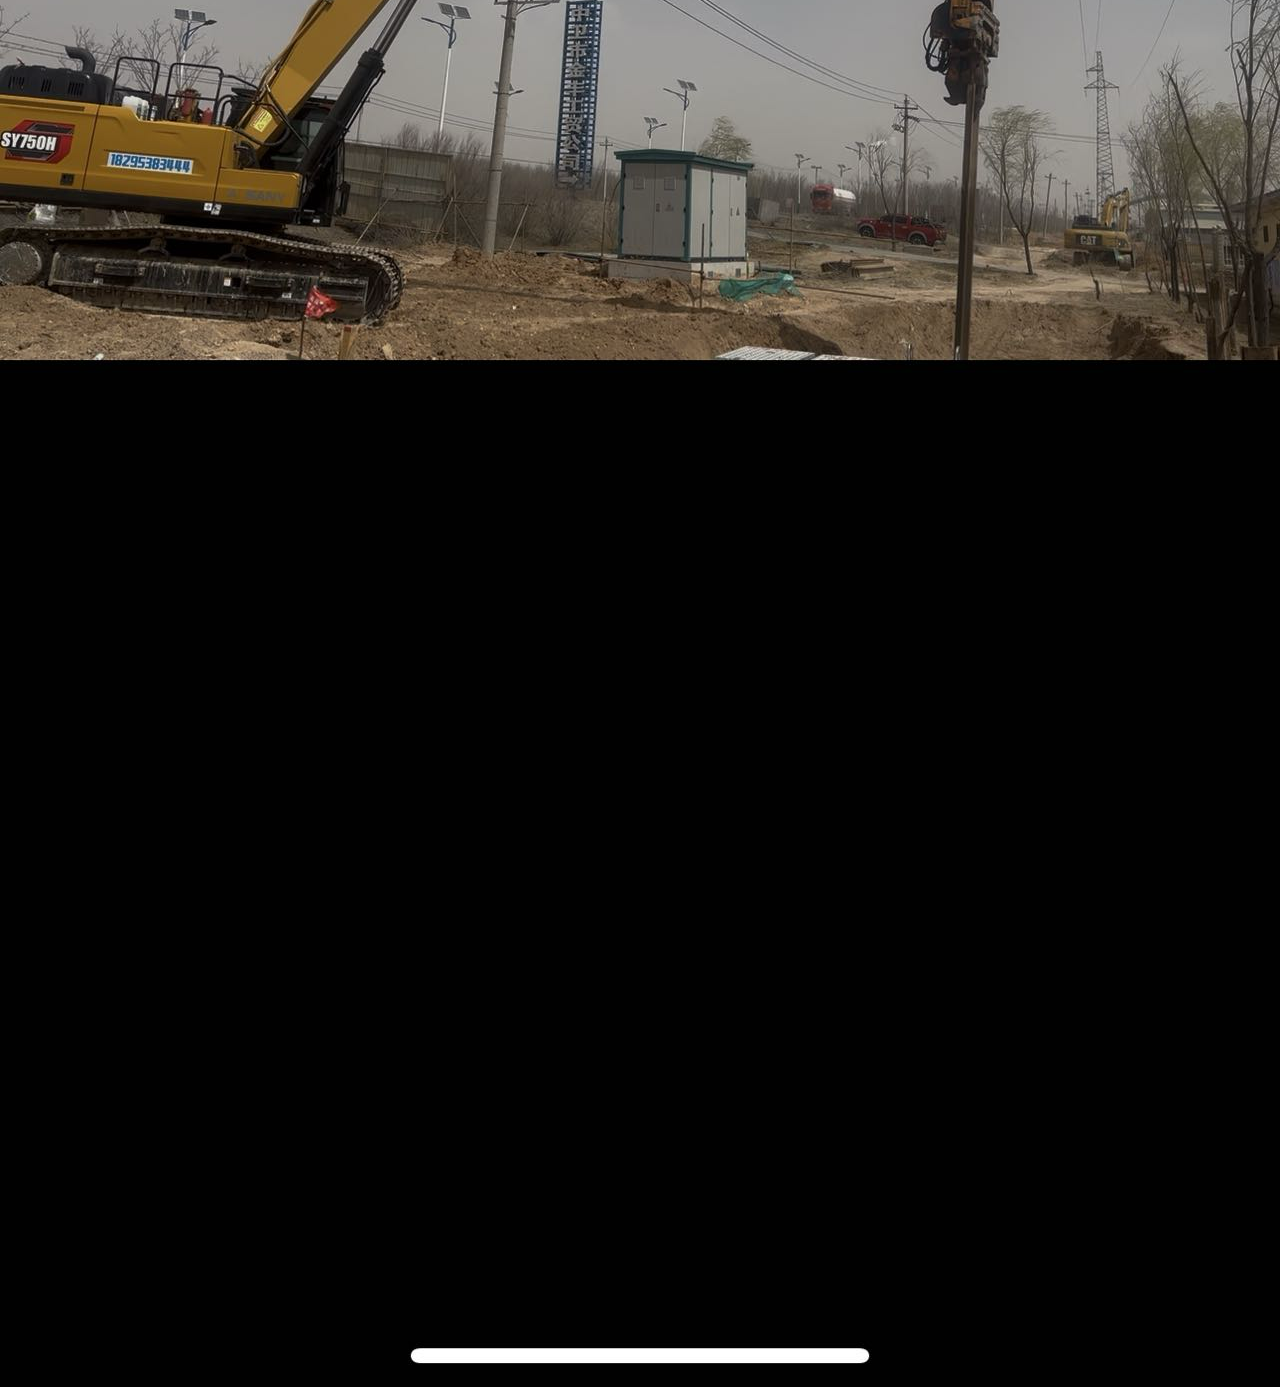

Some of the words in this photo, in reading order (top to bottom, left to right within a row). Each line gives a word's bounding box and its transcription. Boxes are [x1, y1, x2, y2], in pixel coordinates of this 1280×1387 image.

[0, 131, 57, 152] SY750H
[110, 153, 191, 173] 18295383444
[1080, 235, 1097, 246] CAT
